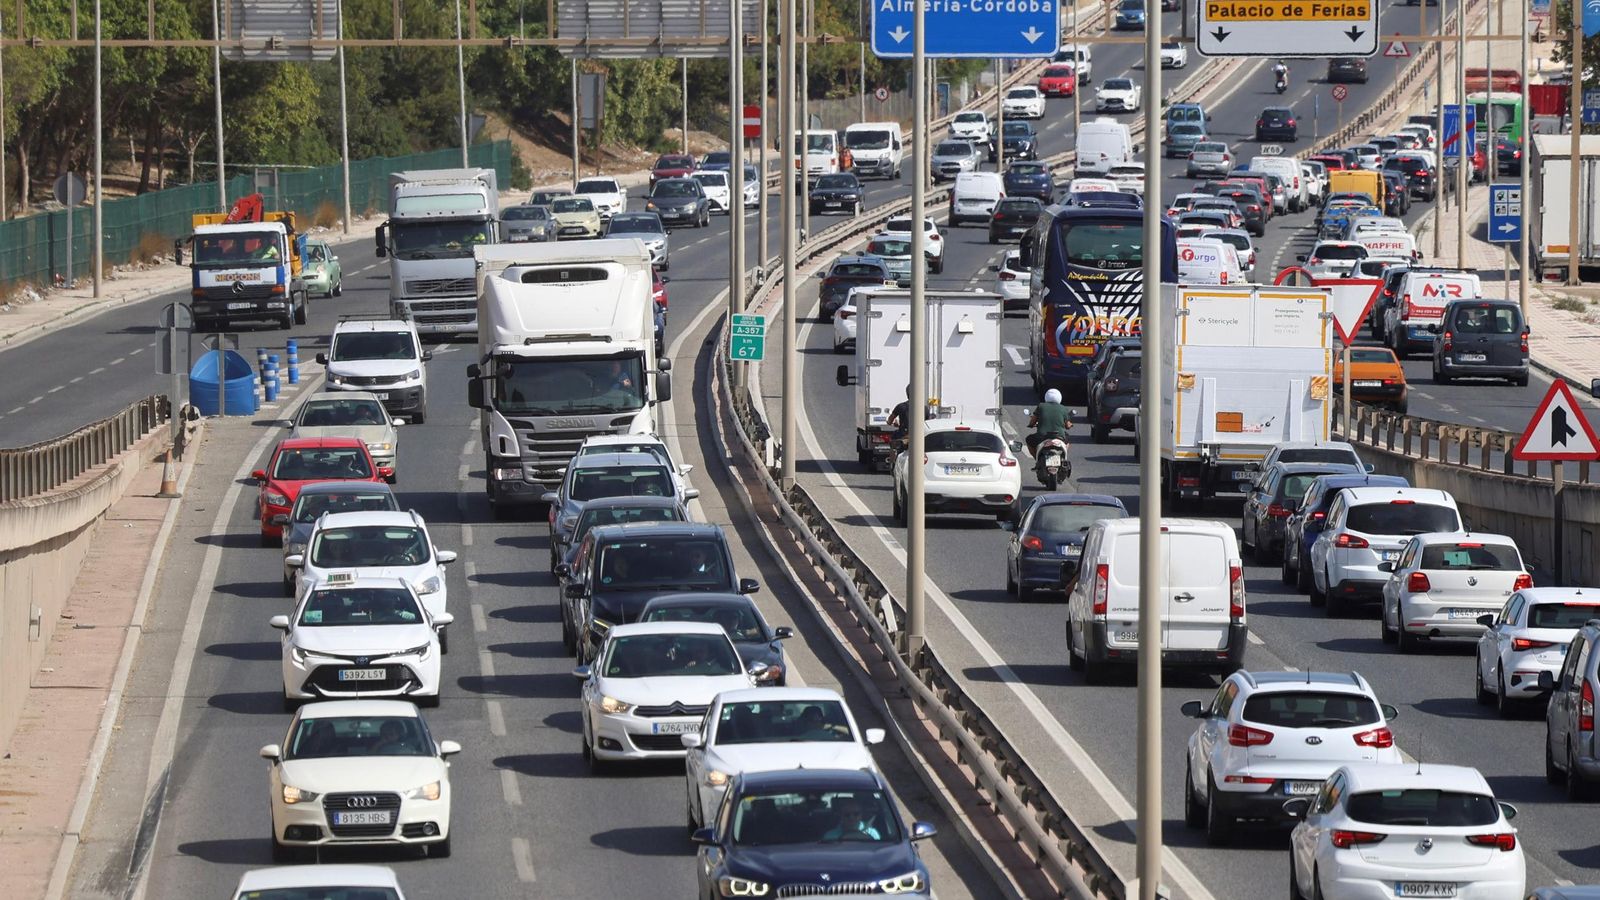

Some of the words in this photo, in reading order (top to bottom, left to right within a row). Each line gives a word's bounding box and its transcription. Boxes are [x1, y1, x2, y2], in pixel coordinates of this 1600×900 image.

[1209, 3, 1275, 17] Palacio
[1282, 3, 1303, 17] de
[1312, 4, 1367, 17] Ferias
[1364, 242, 1405, 250] MAPFRE
[1207, 317, 1239, 326] Stericycle
[737, 326, 760, 336] A-357
[739, 347, 757, 358] 67
[546, 417, 597, 429] SCANIA
[344, 671, 366, 680] 5392
[367, 670, 384, 679] LSY
[660, 724, 681, 733] 4764
[1306, 736, 1321, 745] KIA
[1293, 783, 1317, 793] 8075
[342, 813, 366, 824] 8135
[368, 812, 386, 823] HBS
[1403, 883, 1431, 895] 0907
[1433, 883, 1455, 896] KXK
